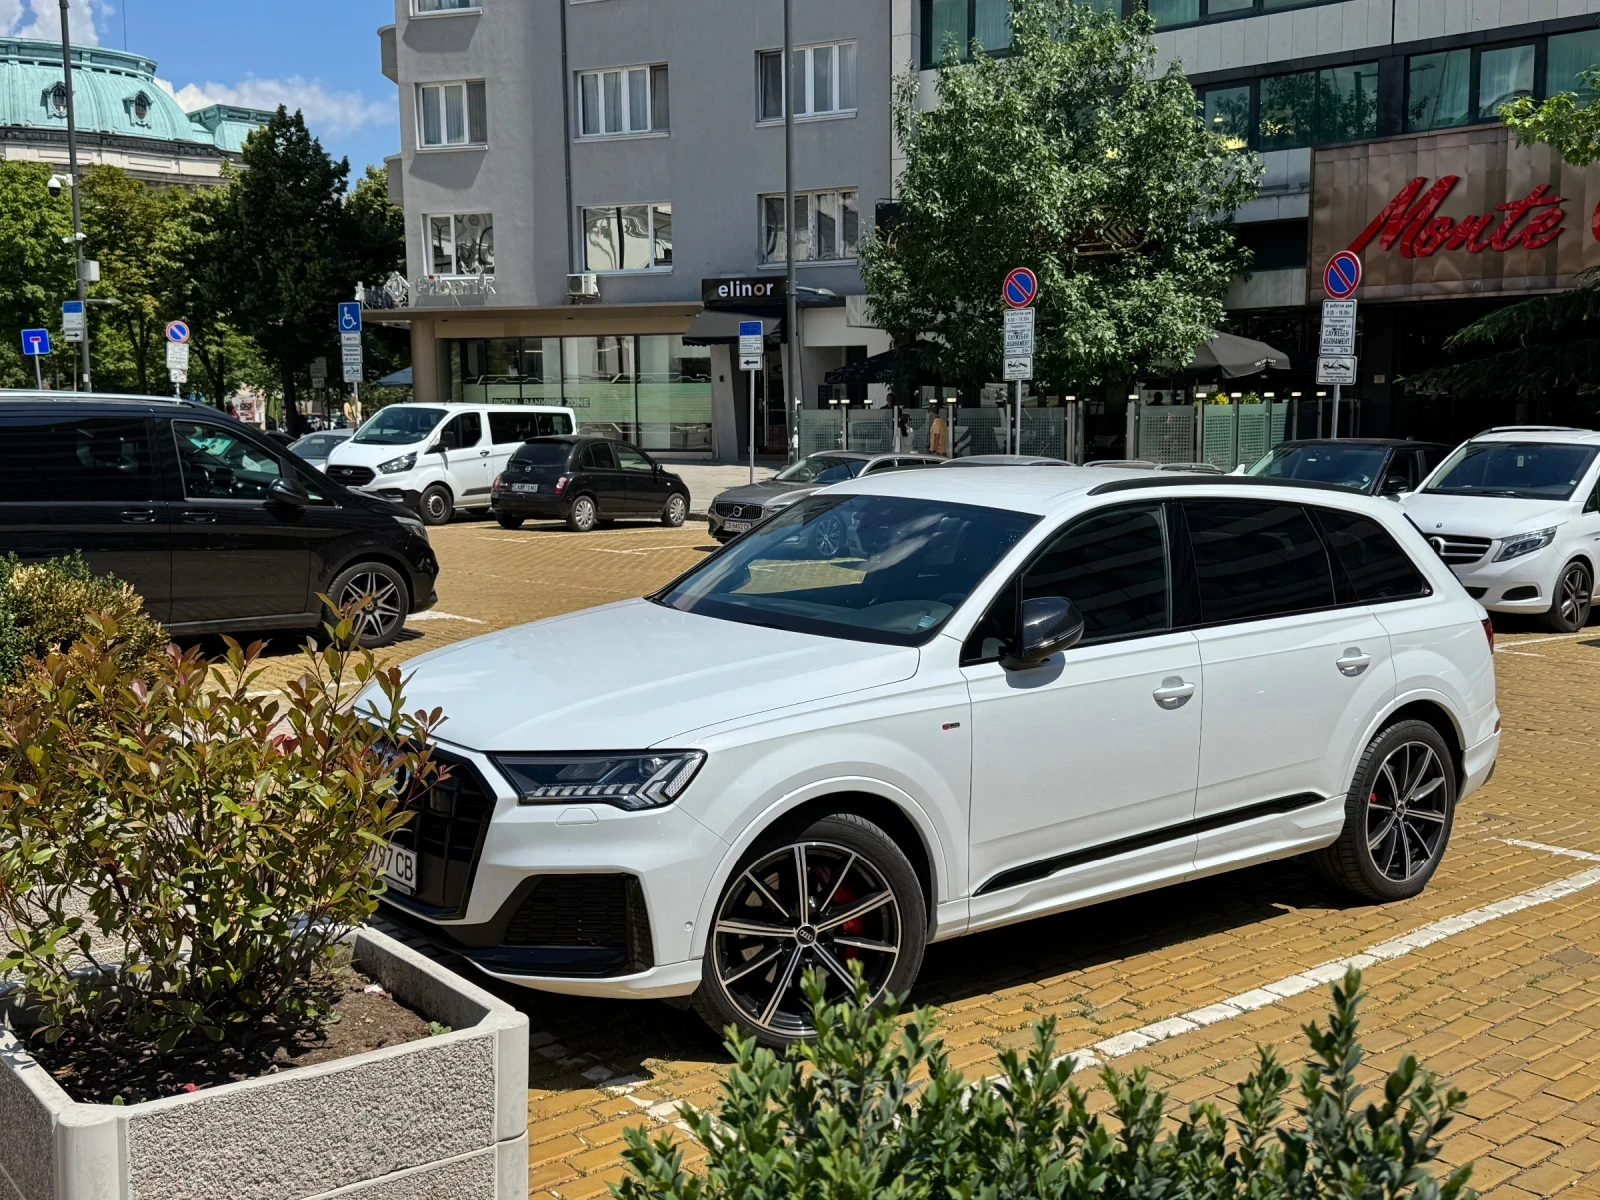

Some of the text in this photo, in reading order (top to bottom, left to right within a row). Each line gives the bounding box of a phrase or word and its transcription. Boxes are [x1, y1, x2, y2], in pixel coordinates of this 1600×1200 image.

[718, 281, 774, 297] elinor
[523, 398, 562, 406] BANKING
[565, 398, 590, 407] ZONE
[396, 852, 414, 882] CB
